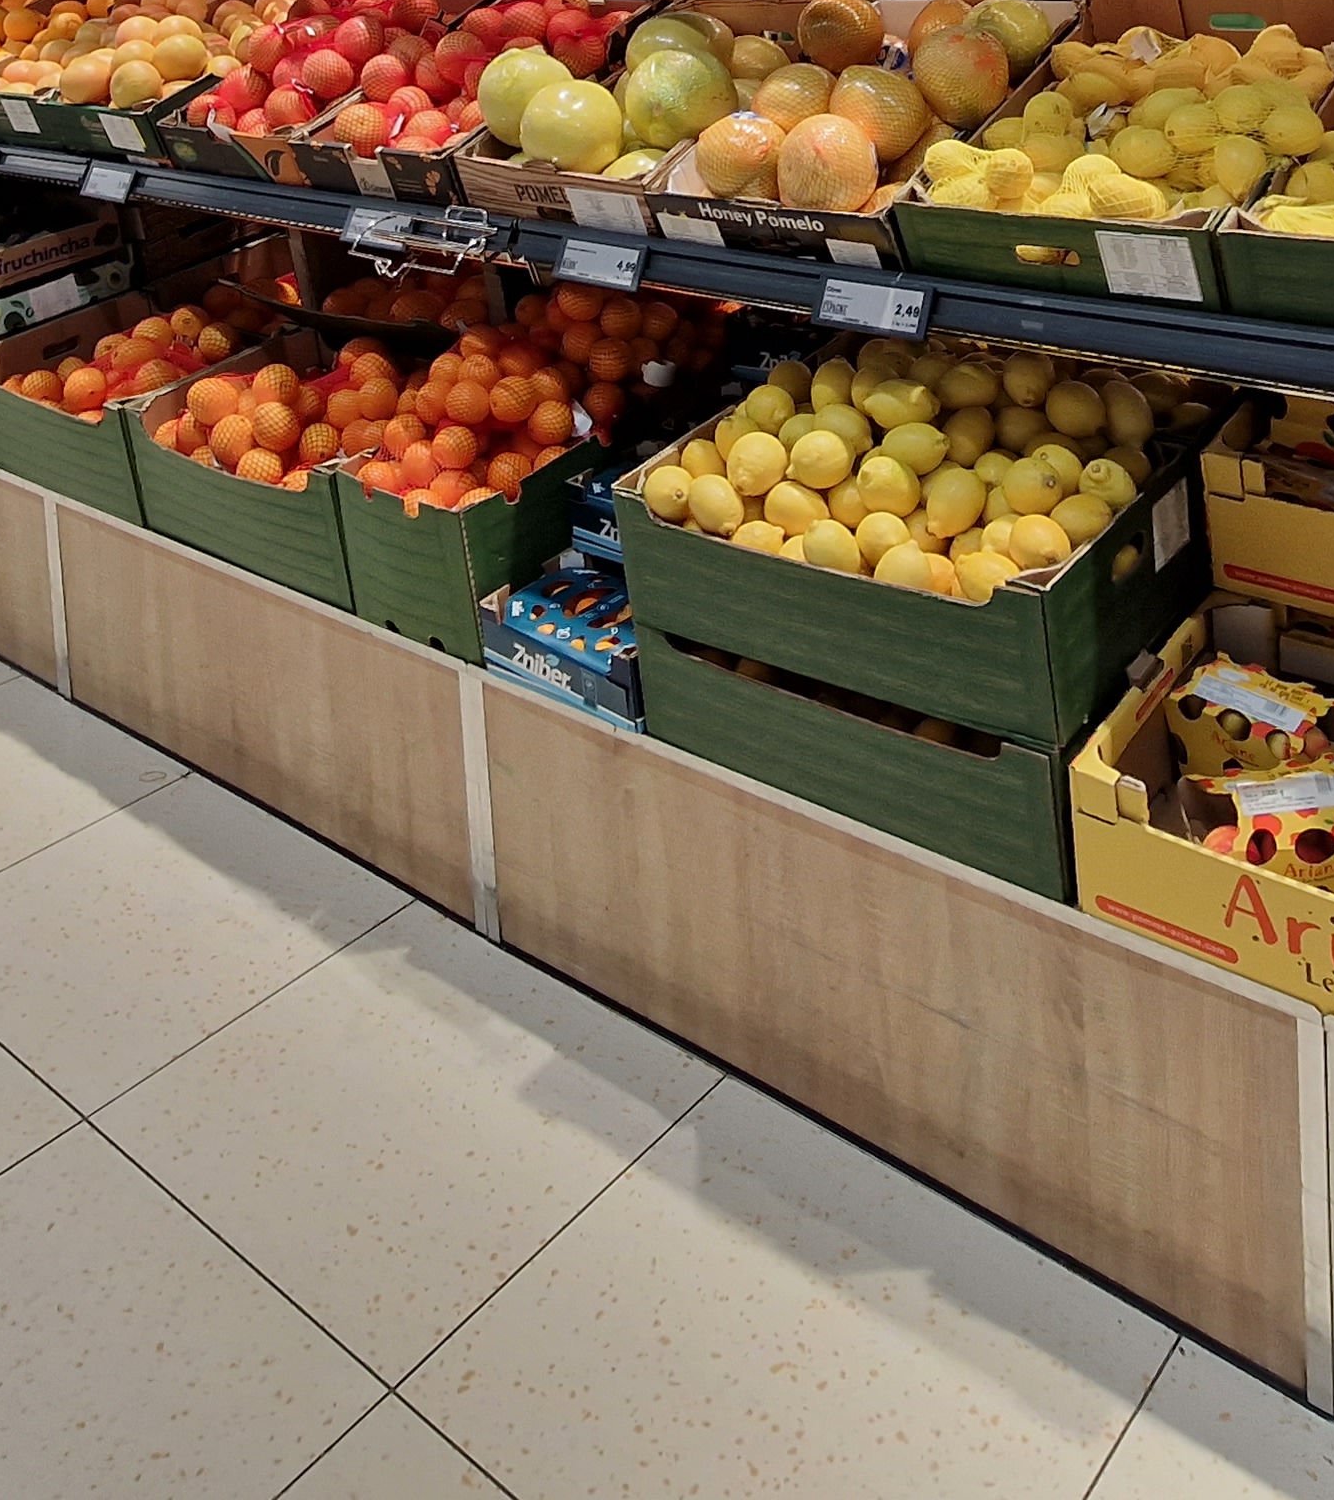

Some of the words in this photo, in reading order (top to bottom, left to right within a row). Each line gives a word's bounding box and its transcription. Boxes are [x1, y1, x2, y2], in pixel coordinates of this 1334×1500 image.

[697, 201, 752, 227] Honey
[755, 210, 825, 233] Pomelo
[894, 303, 920, 319] 2,49
